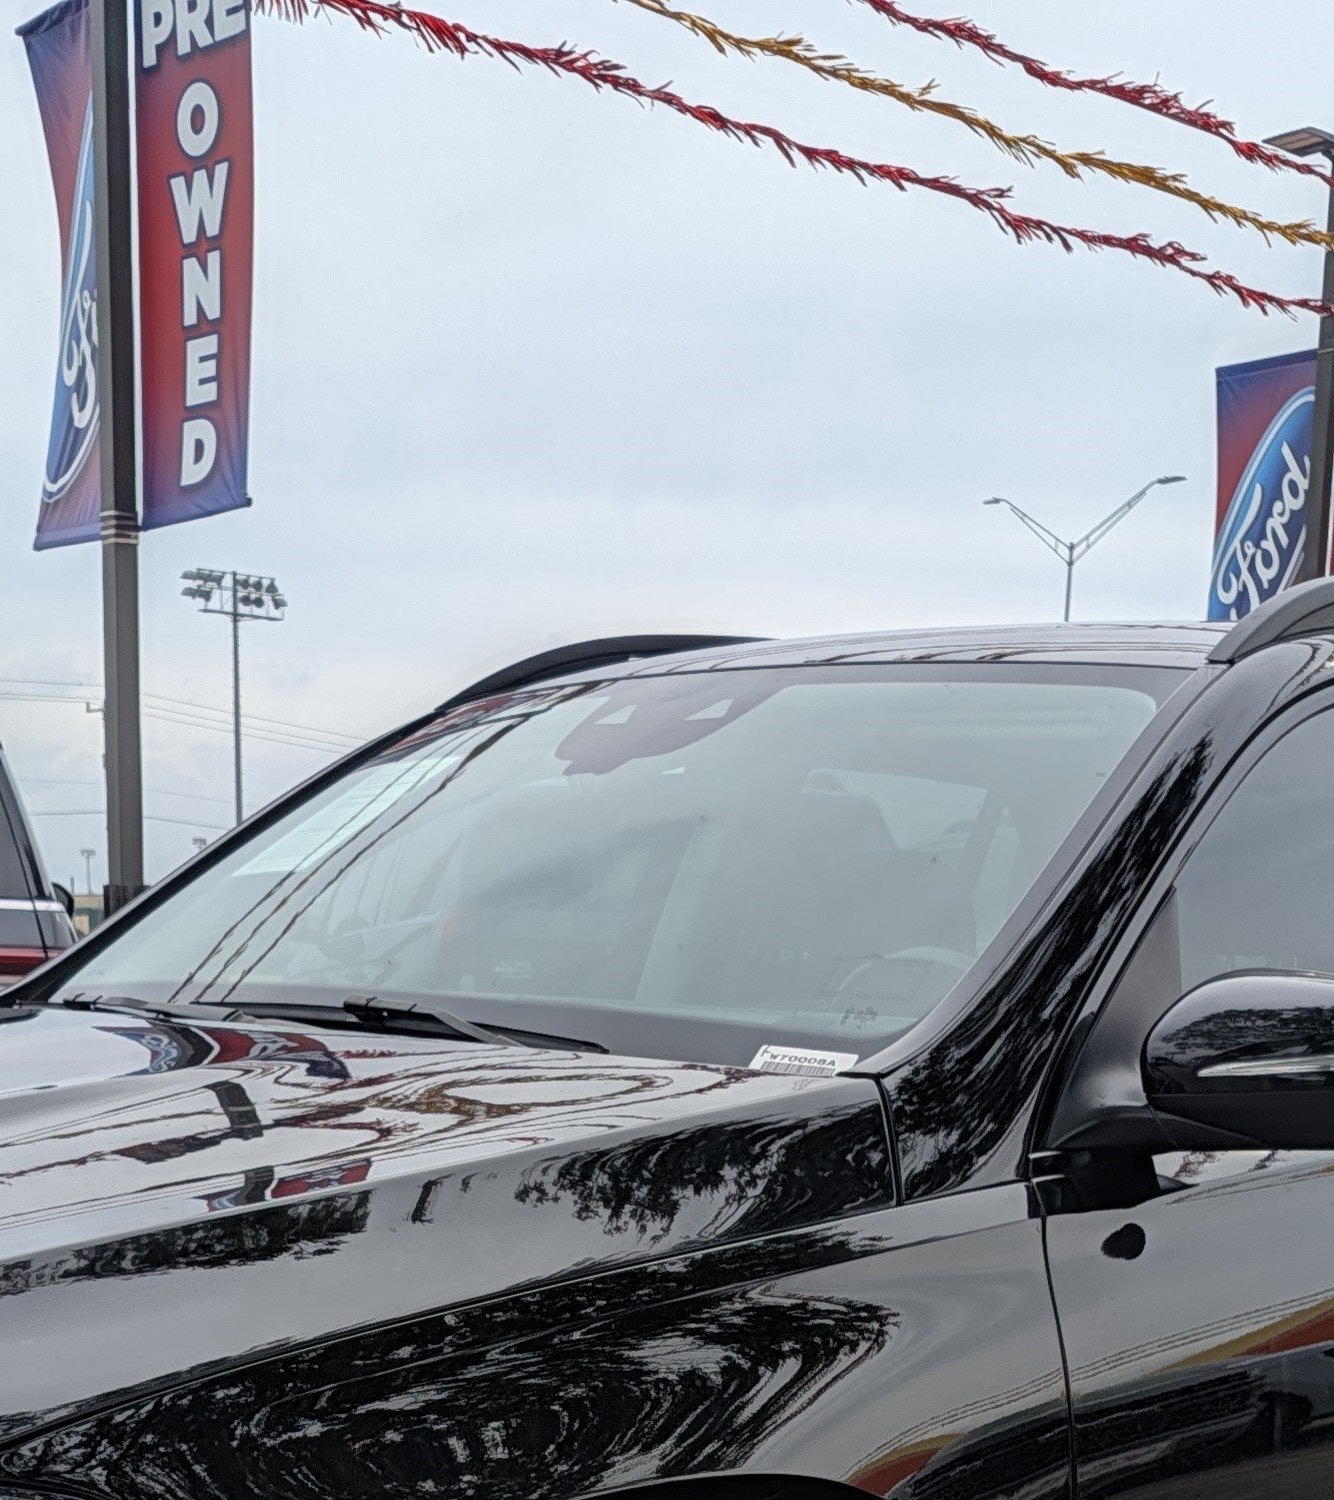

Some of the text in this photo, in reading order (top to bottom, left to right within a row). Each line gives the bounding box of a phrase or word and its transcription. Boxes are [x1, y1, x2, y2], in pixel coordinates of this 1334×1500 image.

[142, 0, 247, 69] PRE
[169, 82, 229, 488] OWNED
[1217, 440, 1311, 620] Ford
